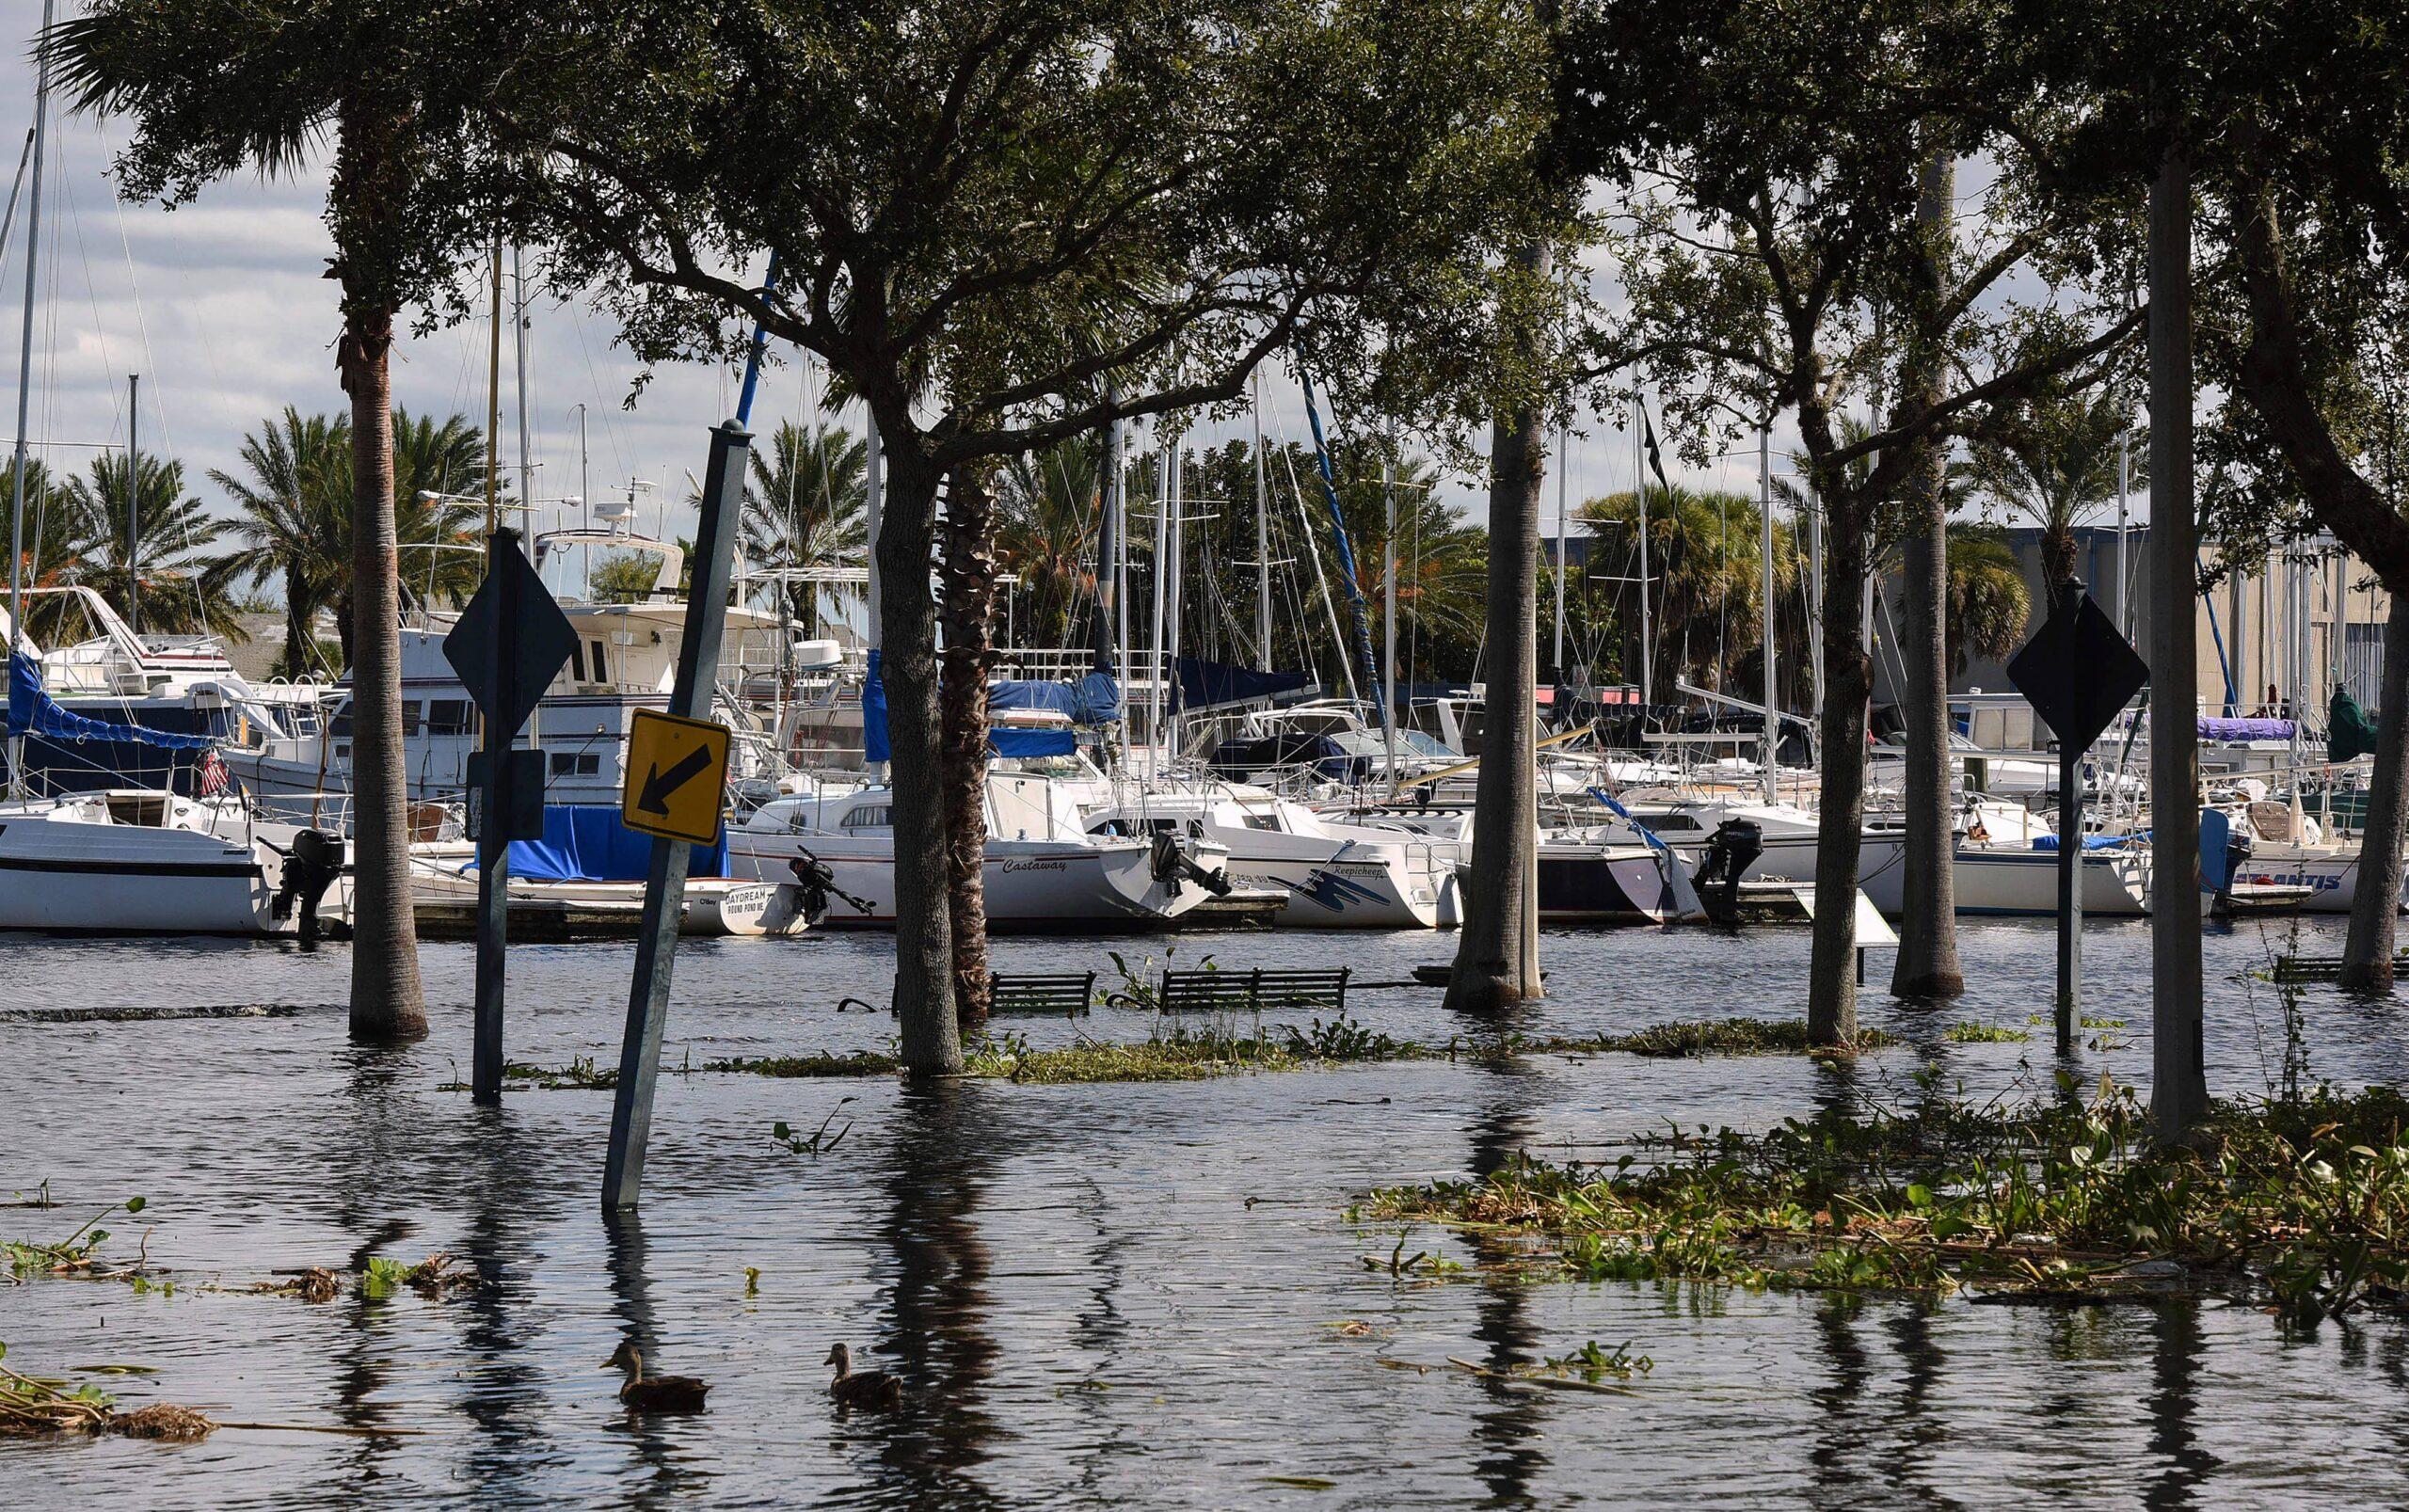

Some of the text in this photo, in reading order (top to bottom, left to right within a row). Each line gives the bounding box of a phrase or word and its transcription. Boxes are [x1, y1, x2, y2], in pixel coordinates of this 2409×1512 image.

[1002, 859, 1067, 874] Castaway
[1332, 865, 1382, 880] Reepicheep
[725, 889, 766, 905] DAYDREAM
[727, 902, 764, 915] ROUND POND ME
